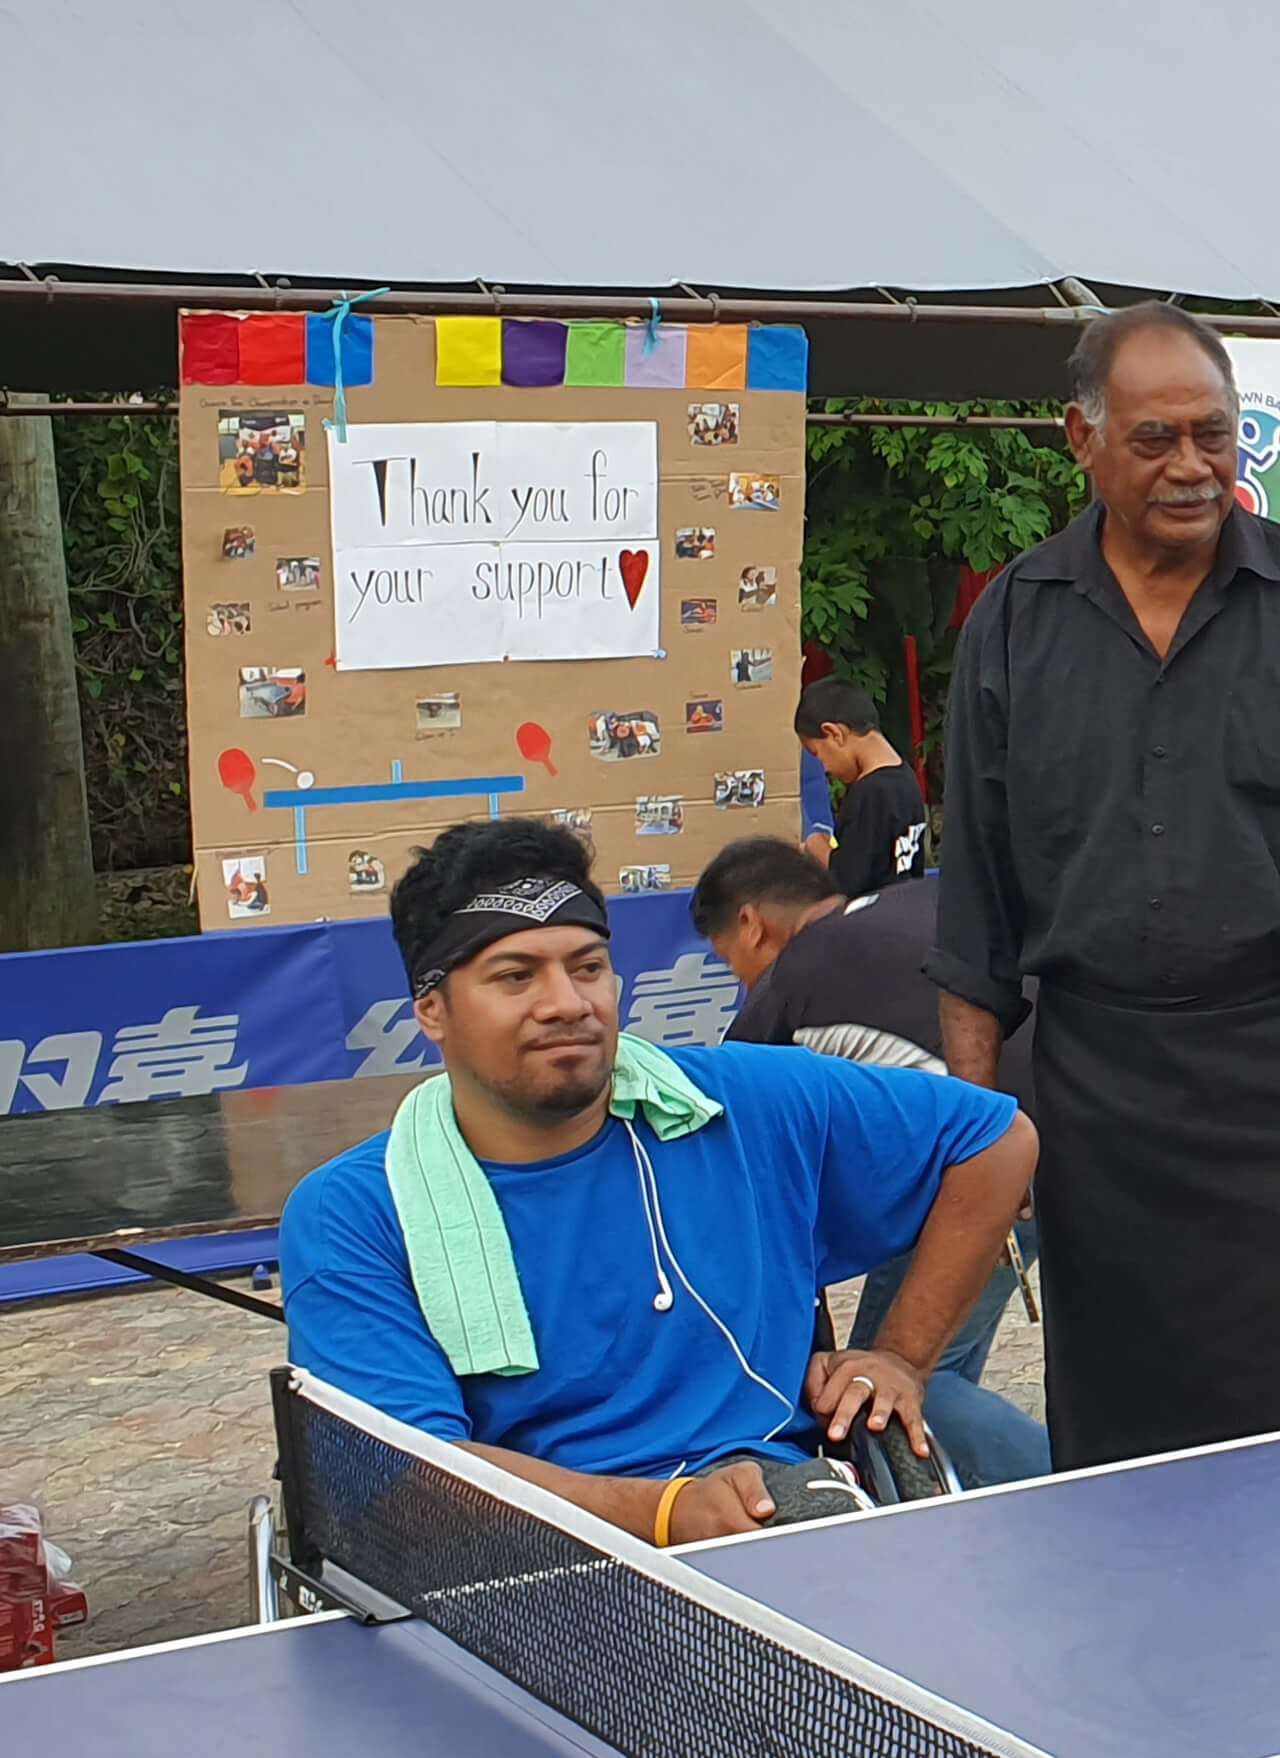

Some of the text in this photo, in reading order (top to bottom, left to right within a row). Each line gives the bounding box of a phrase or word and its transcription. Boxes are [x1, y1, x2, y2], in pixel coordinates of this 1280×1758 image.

[351, 448, 639, 539] Thank you for
[349, 556, 617, 624] your support
